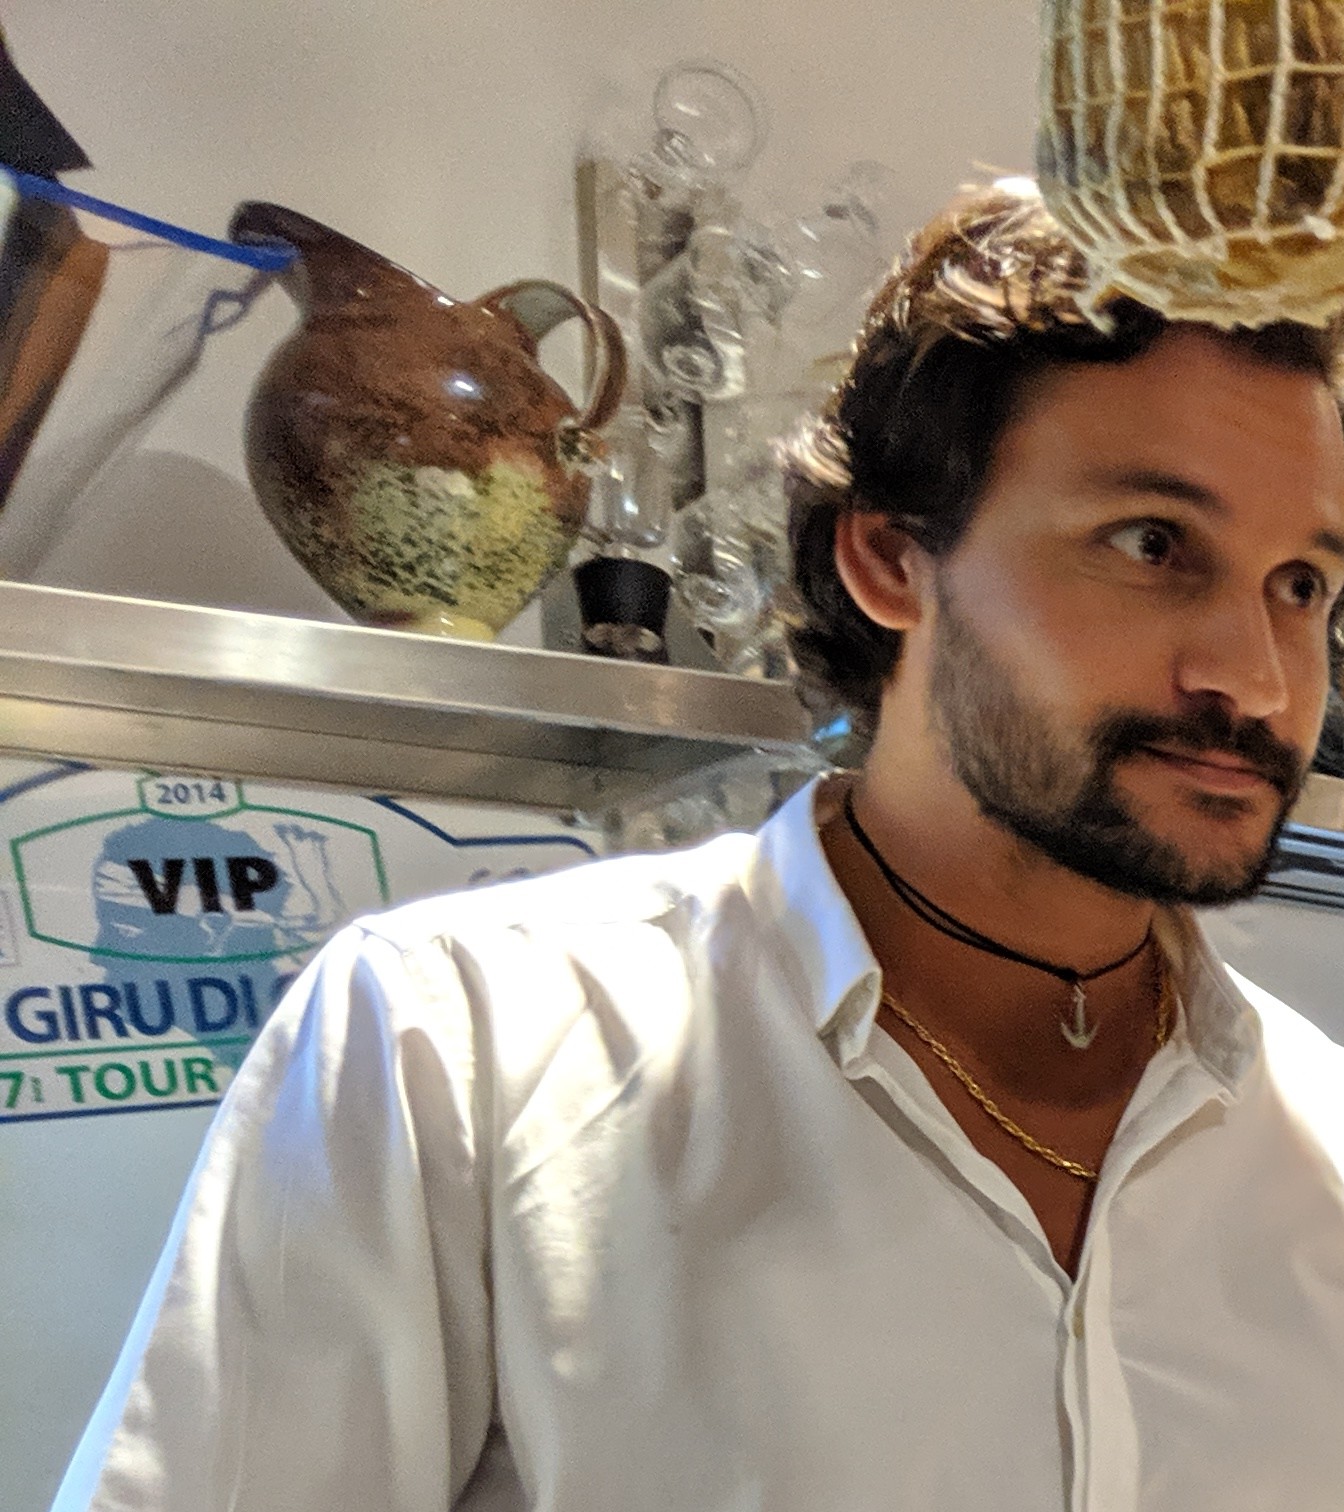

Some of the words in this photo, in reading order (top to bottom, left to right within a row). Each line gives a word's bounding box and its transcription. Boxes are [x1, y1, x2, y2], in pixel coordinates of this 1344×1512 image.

[155, 782, 226, 804] 2014
[127, 856, 279, 915] VIP
[4, 978, 175, 1043] GIRU
[187, 974, 258, 1033] DI
[55, 1056, 219, 1103] TOUR
